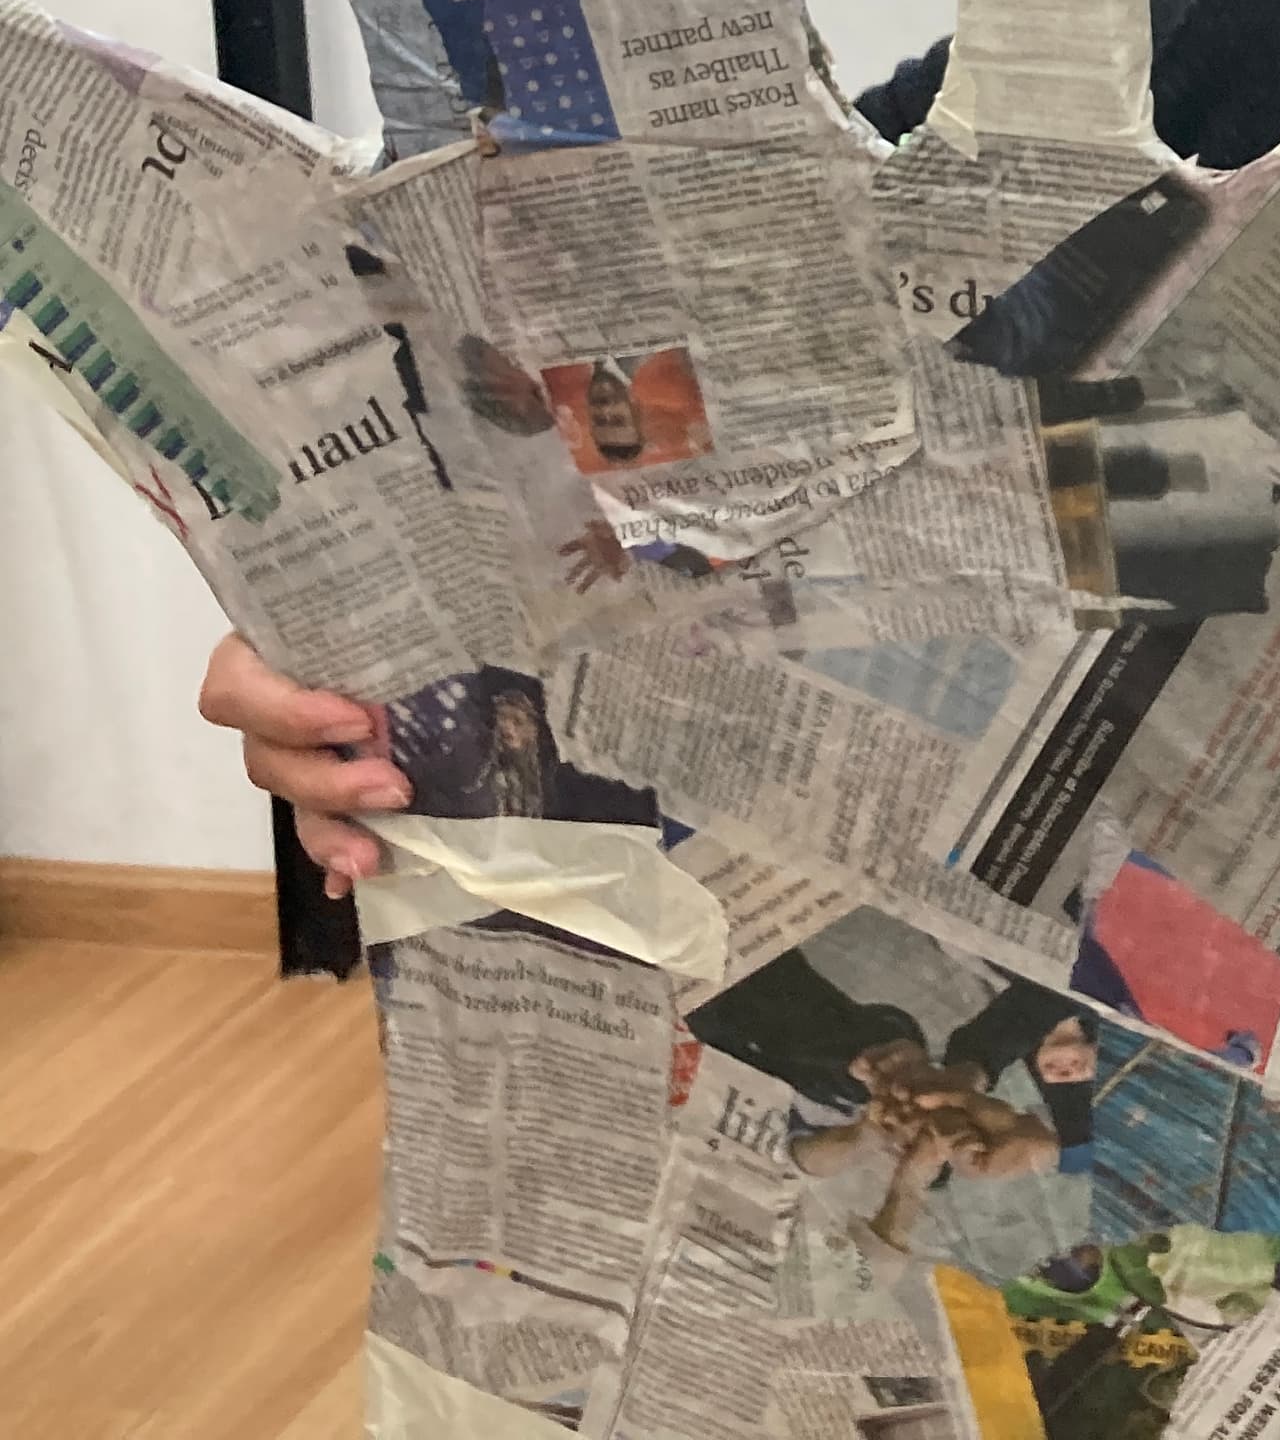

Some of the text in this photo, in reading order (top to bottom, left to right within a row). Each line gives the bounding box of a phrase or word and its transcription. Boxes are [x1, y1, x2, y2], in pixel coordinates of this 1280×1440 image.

[618, 9, 773, 60] new partner
[647, 45, 787, 92] ThaiBev as
[647, 81, 798, 129] Foxes name
